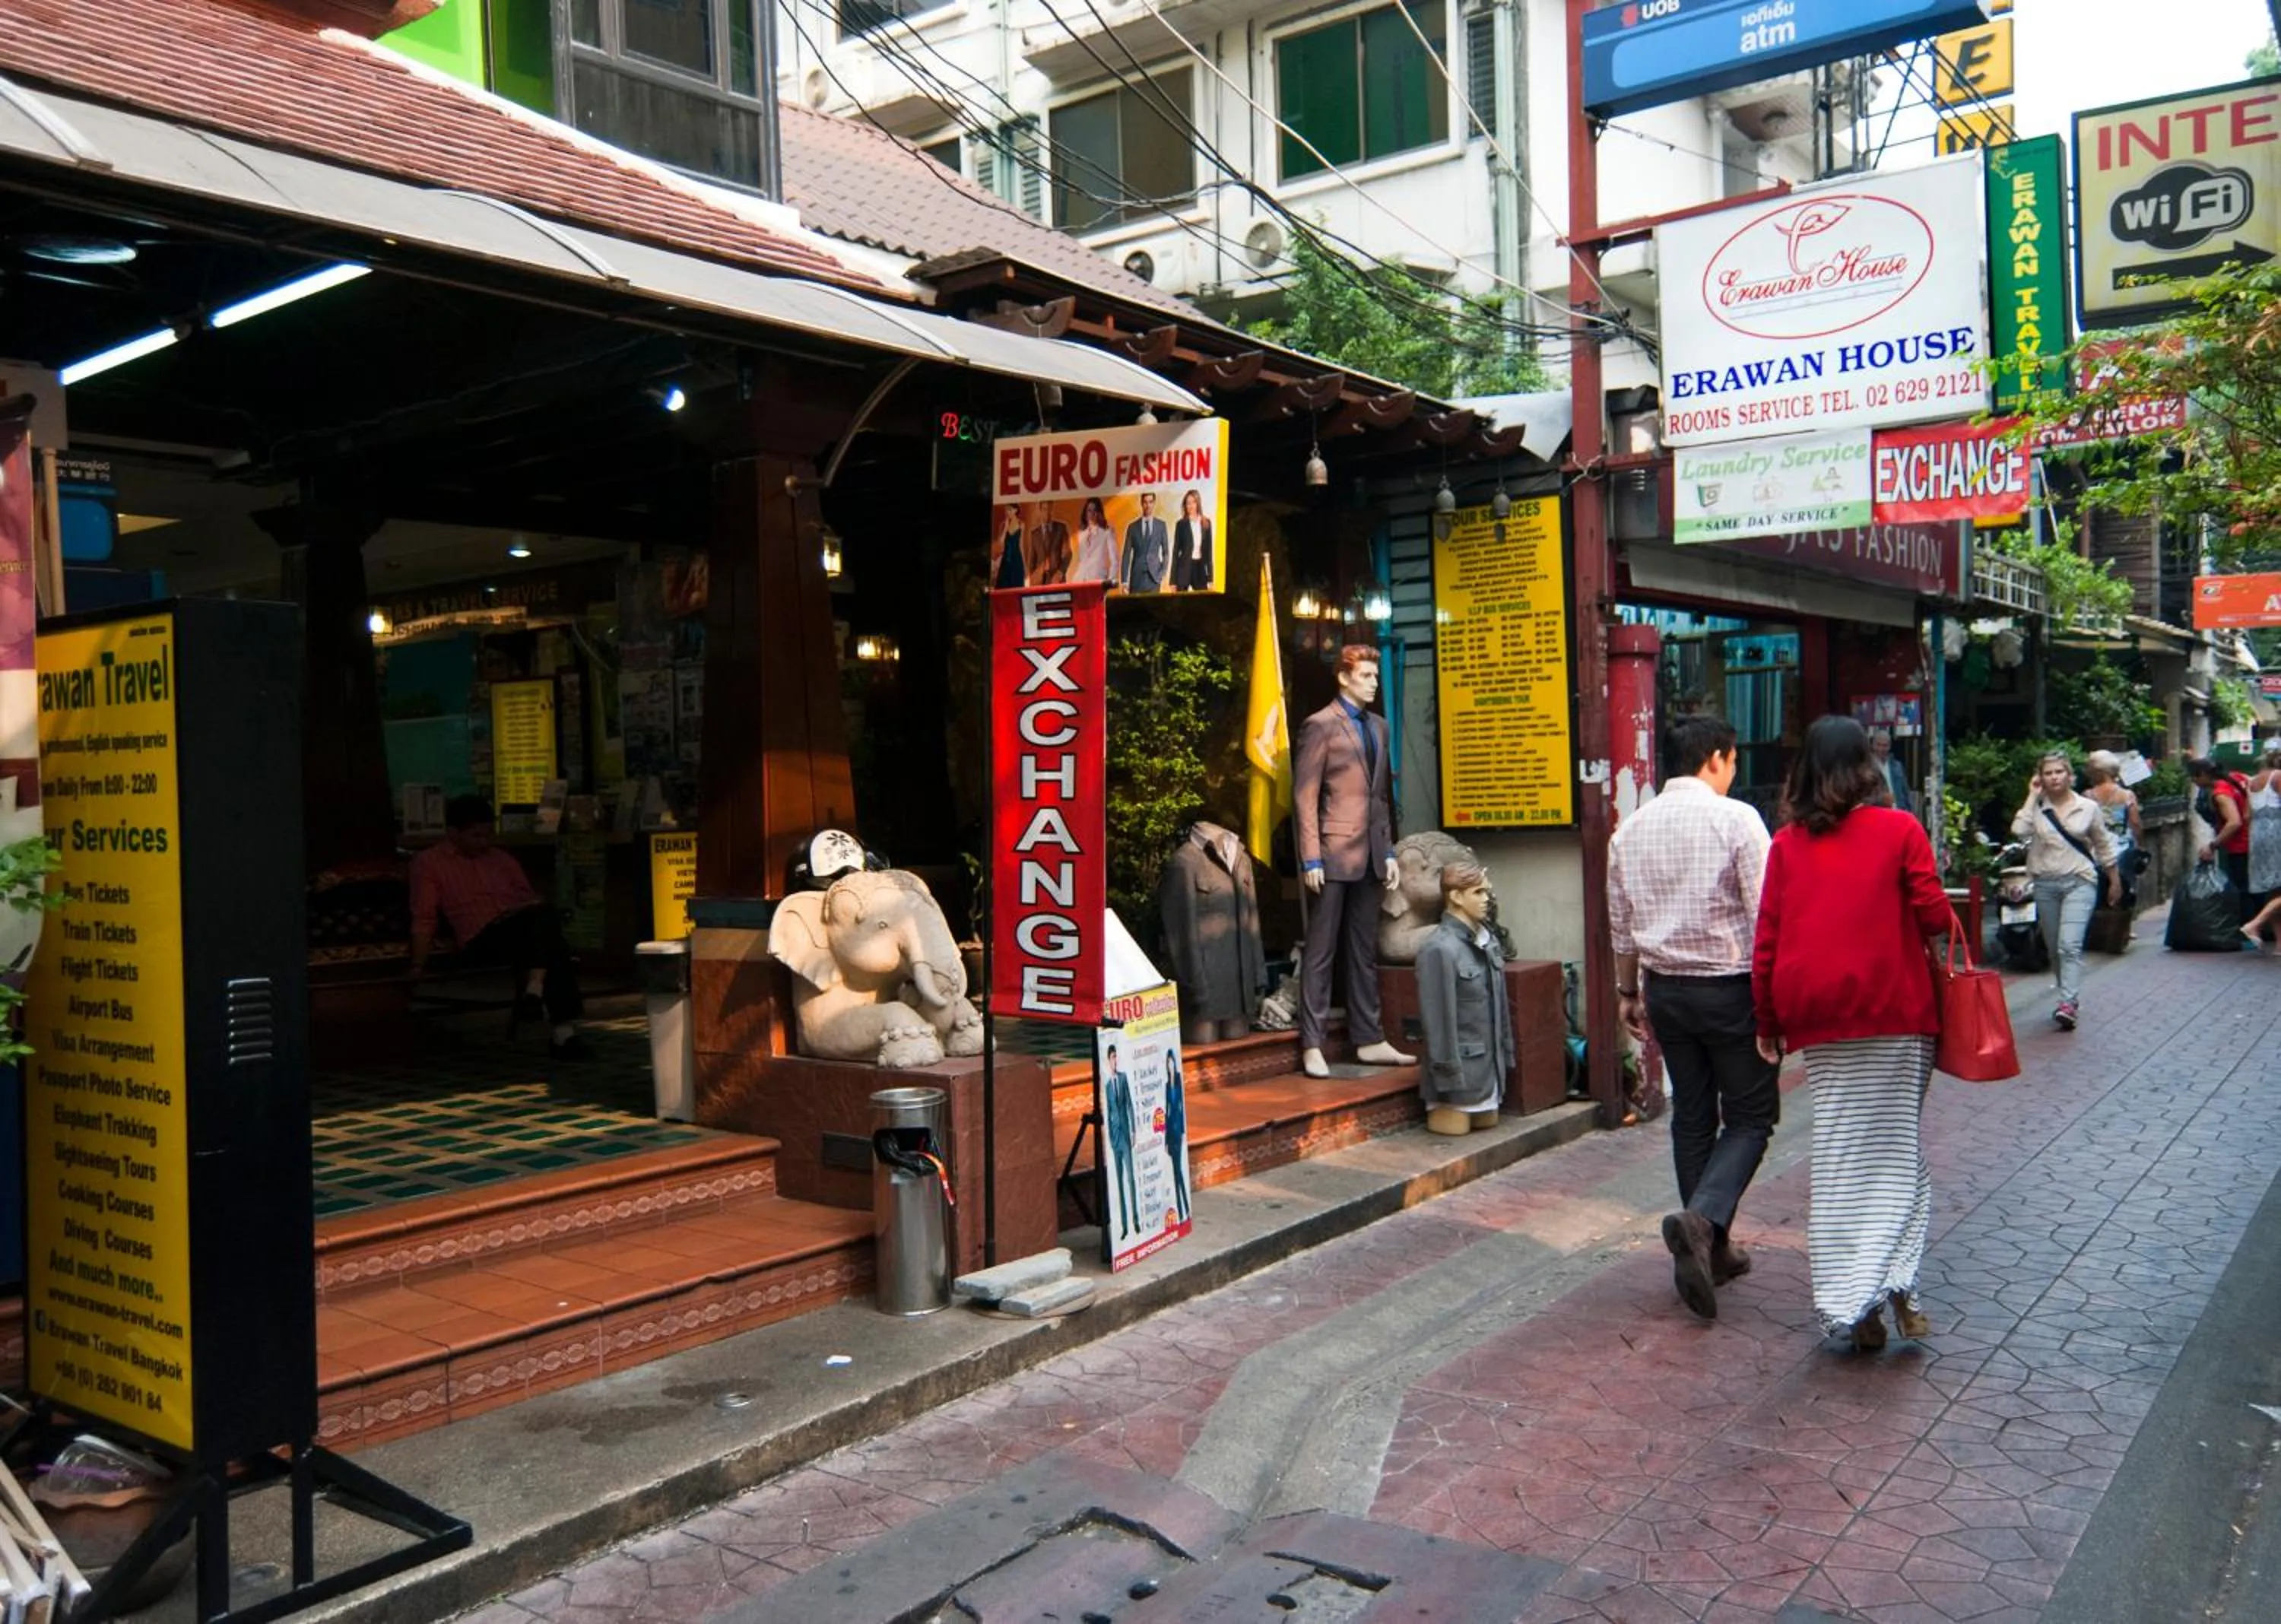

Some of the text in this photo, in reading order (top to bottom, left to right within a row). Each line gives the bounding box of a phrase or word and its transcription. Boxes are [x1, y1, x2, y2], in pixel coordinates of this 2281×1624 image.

[1642, 0, 1680, 20] UOB
[1740, 21, 1795, 53] atm
[2008, 171, 2042, 278] ERAWAN
[1718, 244, 1909, 306] Erawan House
[1672, 326, 1975, 398] ERAWAN HOUSE
[1669, 371, 1984, 435] ROOMS SERVICE TEL. 02 629 2121
[1000, 439, 1211, 496] EURO FASHION
[1680, 440, 1869, 482] Laundry Service
[1875, 437, 2023, 503] EXCHANGE
[1480, 501, 1541, 523] SEICES
[1748, 513, 1773, 527] DAY
[1854, 525, 1943, 576] FASHION
[100, 643, 169, 706] Travel
[132, 772, 157, 795] 22:00
[1014, 590, 1084, 1016] EXCHANGE
[44, 818, 168, 852] ur Services
[86, 881, 131, 905] Tickets
[62, 918, 138, 944] Train Tickets
[61, 956, 139, 984] Flight Tickets
[68, 994, 134, 1023] Airport Bus
[51, 1029, 155, 1064] Visa Arrangement
[38, 1064, 172, 1106] Passport Photo Service
[105, 1112, 157, 1149] Trekking
[122, 1154, 157, 1184] Tours
[58, 1178, 155, 1223] Cooking Courses
[63, 1216, 154, 1261] Diving Courses
[49, 1247, 75, 1277] And
[77, 1261, 114, 1287] much
[1115, 1251, 1135, 1270] FREE
[49, 1318, 183, 1382] Erawan Travel Bangkok
